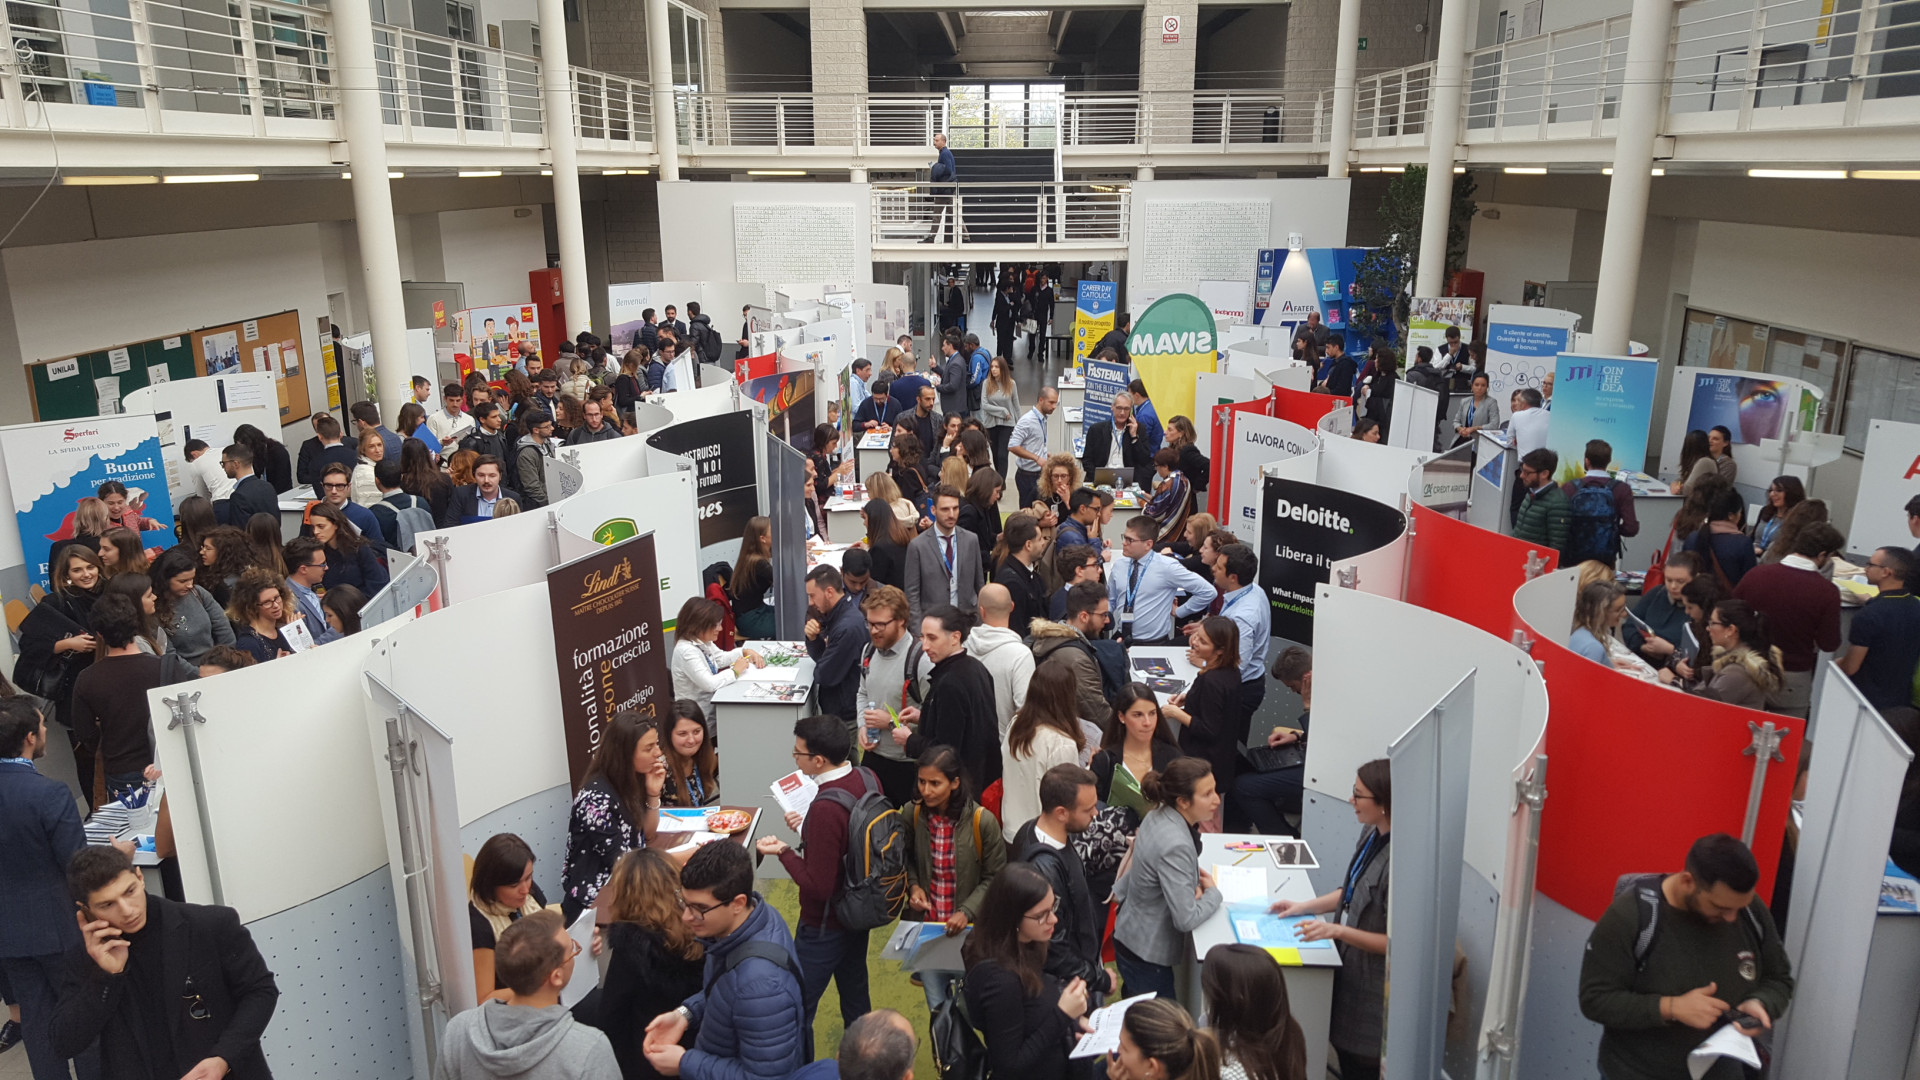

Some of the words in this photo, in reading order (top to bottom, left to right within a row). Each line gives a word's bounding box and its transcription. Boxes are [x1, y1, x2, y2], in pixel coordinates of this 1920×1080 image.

[1261, 267, 1270, 275] in
[1081, 291, 1111, 299] CATTOLICA
[1082, 284, 1101, 292] CAREER
[1101, 285, 1112, 293] DAY
[616, 296, 648, 307] Benvenuti
[52, 363, 75, 375] UNILAB
[1599, 365, 1624, 375] JOIN
[1597, 374, 1621, 384] THE
[1095, 381, 1103, 391] THE
[1102, 383, 1114, 394] BLUE
[1597, 382, 1624, 393] IDEA
[60, 446, 82, 454] SFIDA
[82, 444, 96, 452] DEL
[97, 441, 120, 450] GUSTO
[1246, 431, 1285, 450] LAVORA
[1286, 441, 1302, 456] CON
[104, 457, 154, 475] Buoni
[703, 458, 722, 474] NOI
[90, 479, 107, 488] per
[108, 471, 156, 484] tradizione
[700, 473, 722, 488] FUTURO
[1275, 544, 1313, 564] Libera
[1316, 553, 1323, 567] il
[581, 564, 621, 598] Lindt
[592, 590, 625, 609] CHOCOLATIER
[625, 582, 640, 594] SUISSE
[1272, 586, 1291, 598] What
[596, 602, 614, 614] DEPUIS
[572, 621, 649, 670] formazione
[611, 640, 651, 669] crescita
[616, 684, 654, 714] prestigio
